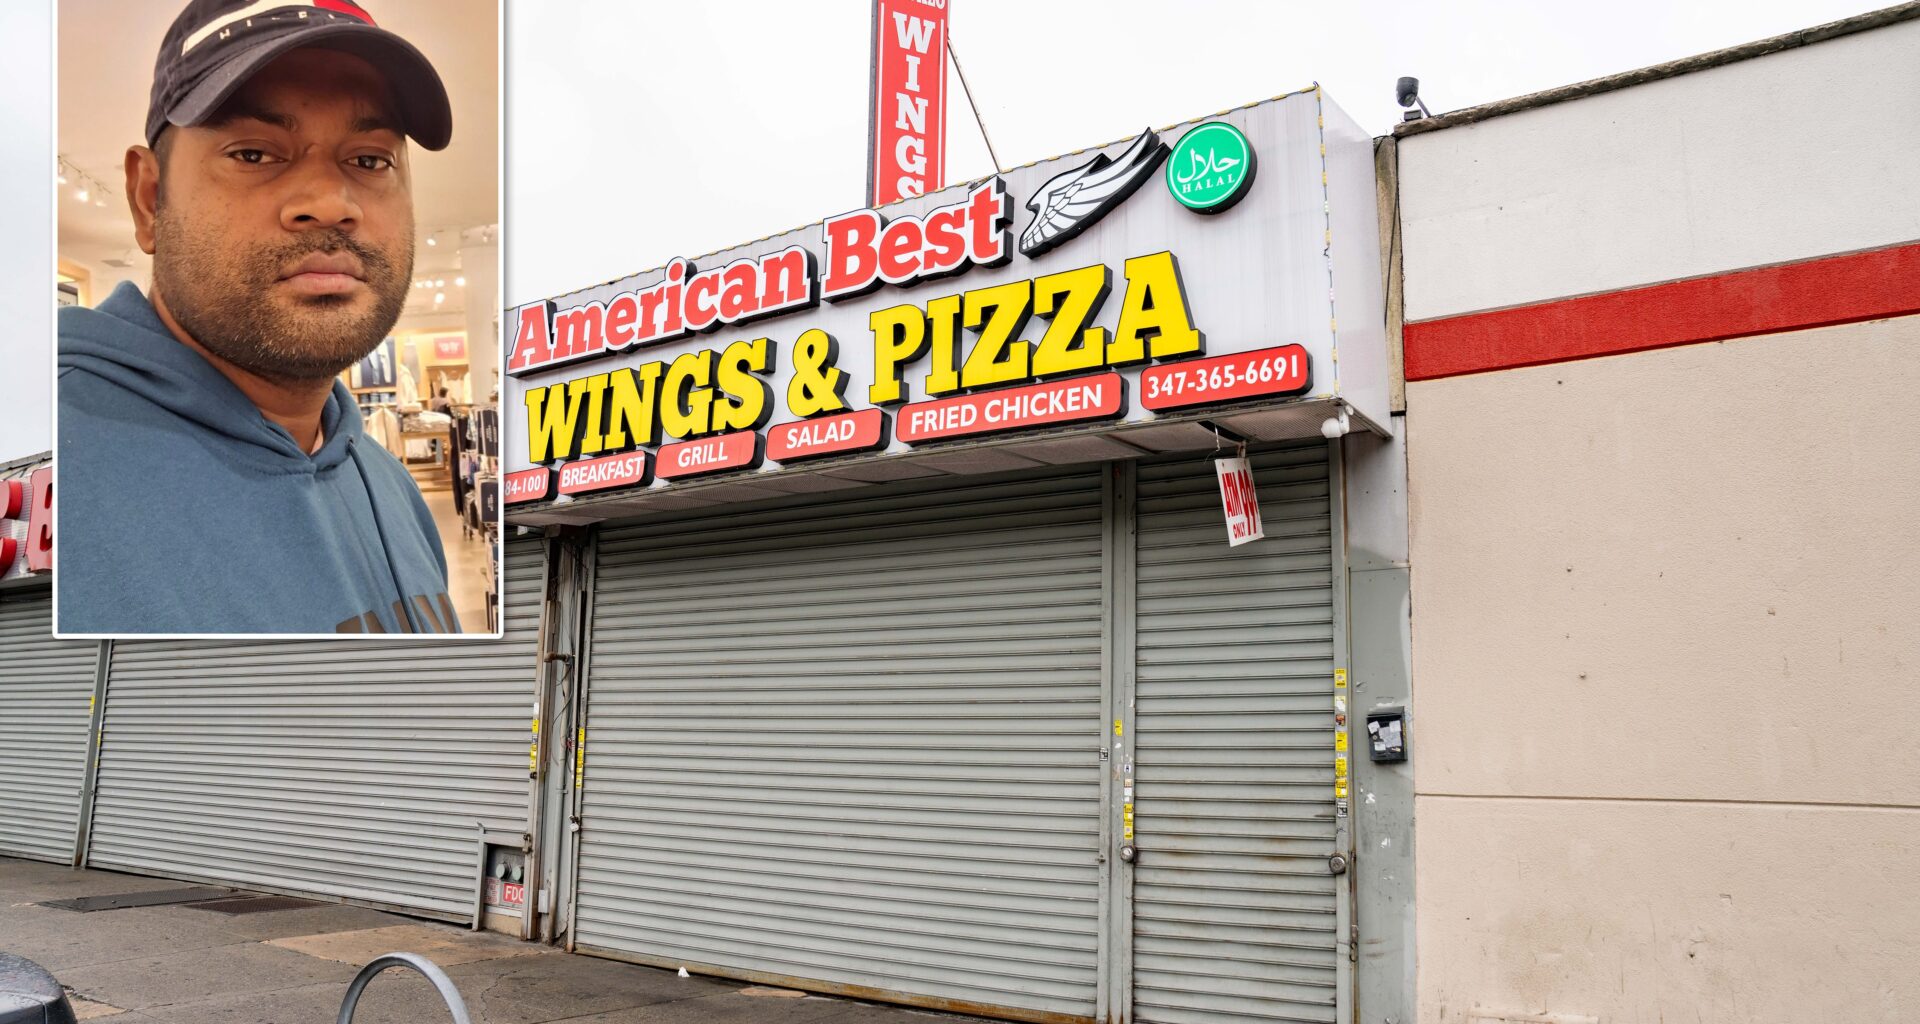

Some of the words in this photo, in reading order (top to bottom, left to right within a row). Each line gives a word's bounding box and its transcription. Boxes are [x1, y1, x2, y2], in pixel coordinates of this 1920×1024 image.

[892, 11, 936, 199] WINGS
[1177, 147, 1240, 183] حلال
[1182, 173, 1235, 194] HALAL
[507, 247, 809, 373] American
[823, 178, 1003, 299] Best
[525, 338, 768, 463] WINGS
[787, 329, 845, 416] &
[869, 250, 1200, 404] PIZZA
[1148, 355, 1298, 398] 347-365-6691
[910, 404, 977, 434] FRIED
[984, 384, 1102, 422] CHICKEN
[786, 420, 856, 449] SALAD
[561, 456, 644, 488] BREAKFAST
[677, 442, 728, 468] GRILL
[503, 474, 546, 496] 84-1001
